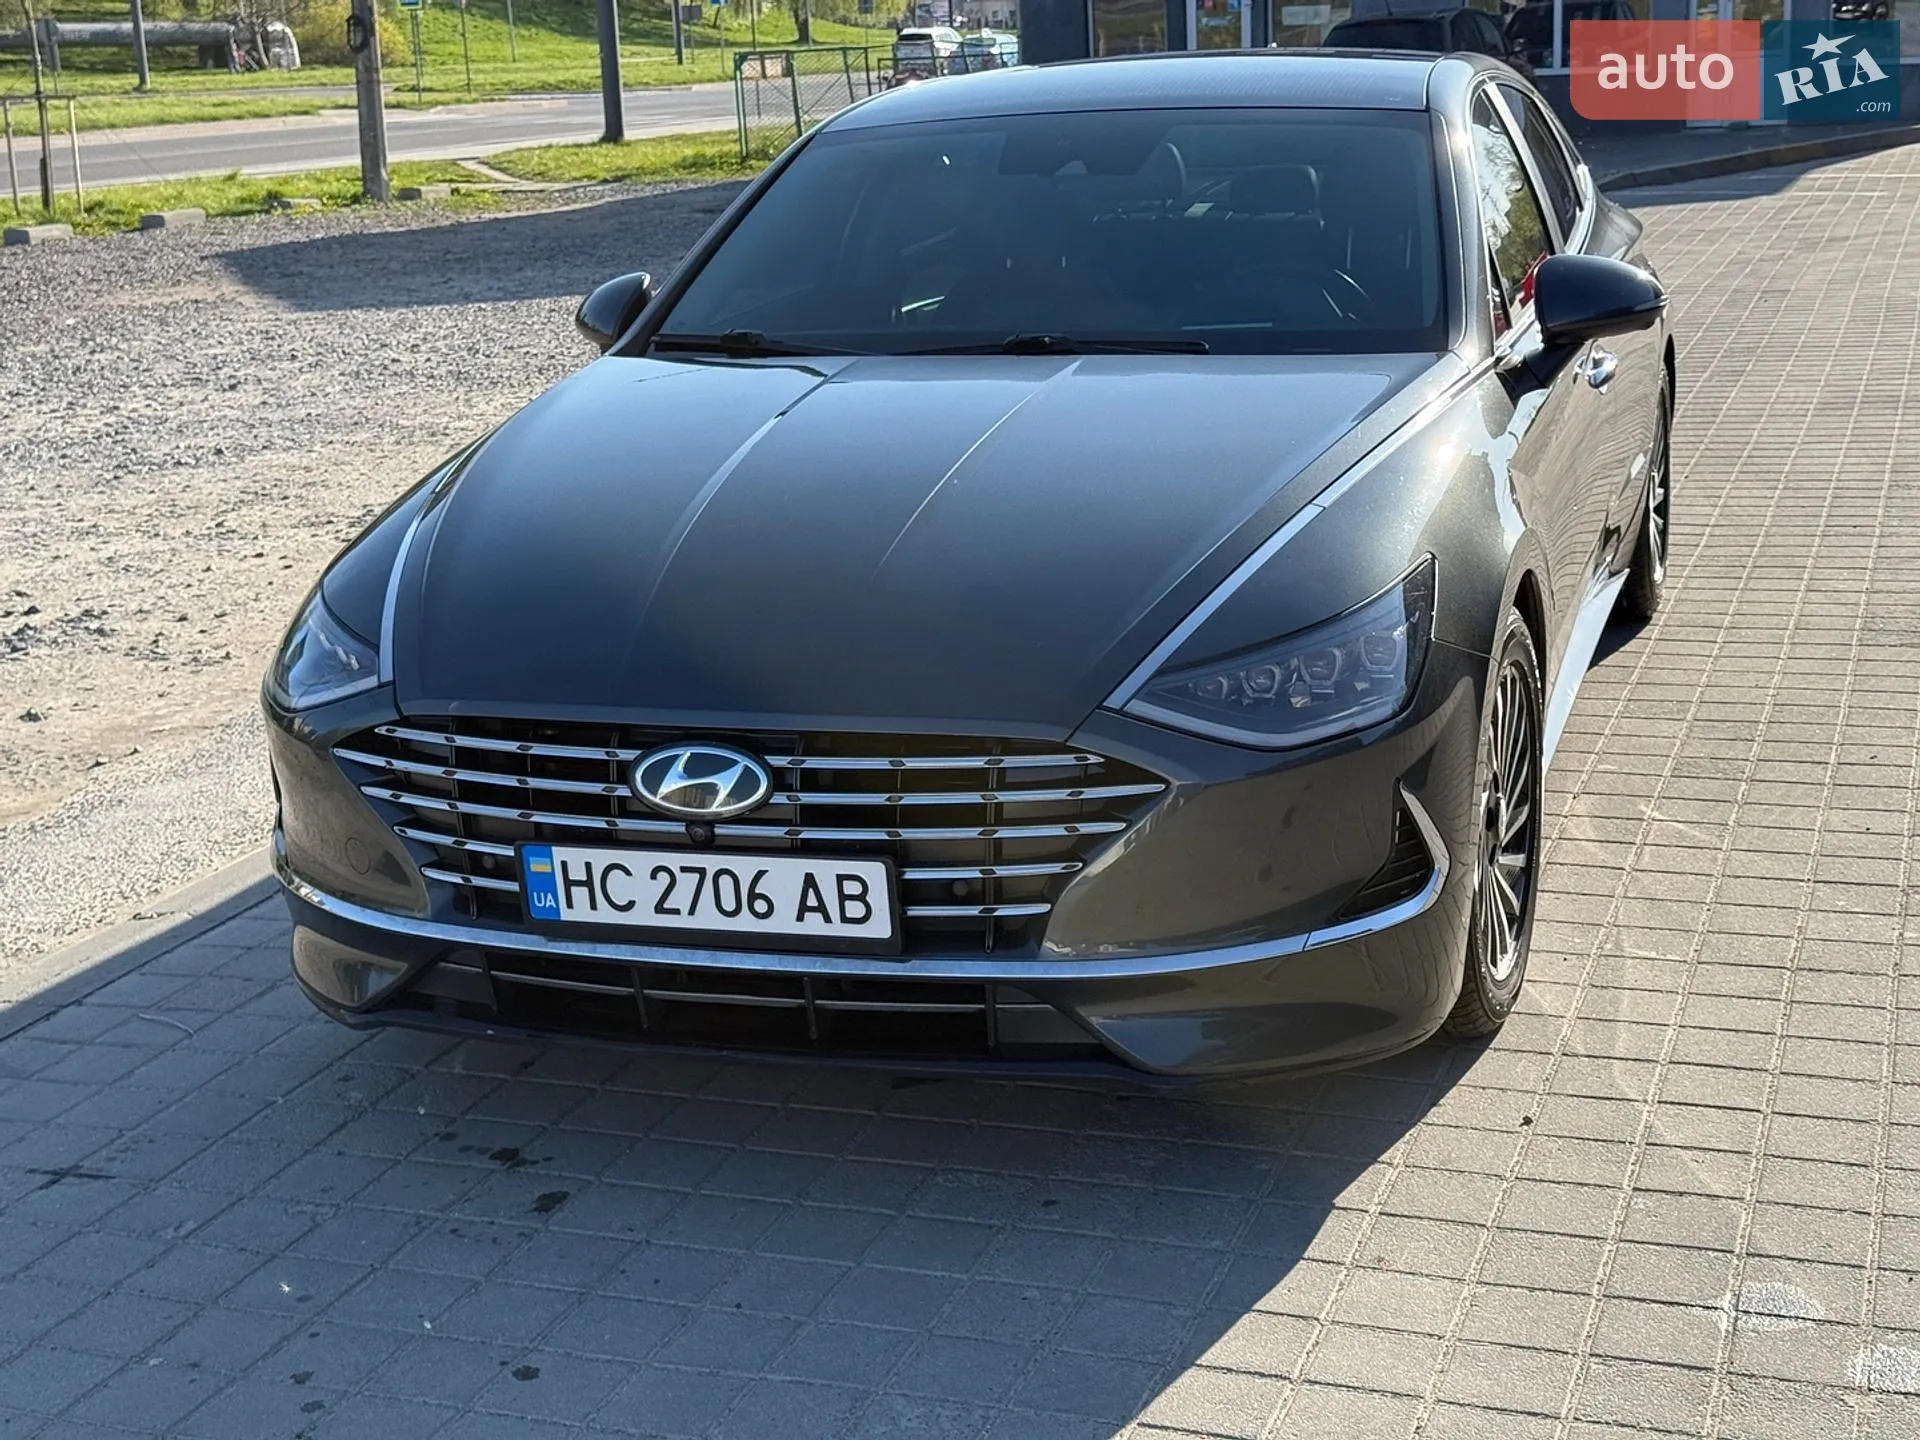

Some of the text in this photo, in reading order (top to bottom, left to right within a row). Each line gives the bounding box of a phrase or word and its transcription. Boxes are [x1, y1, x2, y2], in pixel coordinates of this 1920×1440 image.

[533, 891, 557, 909] UA
[560, 860, 873, 925] HC 2706 AB
